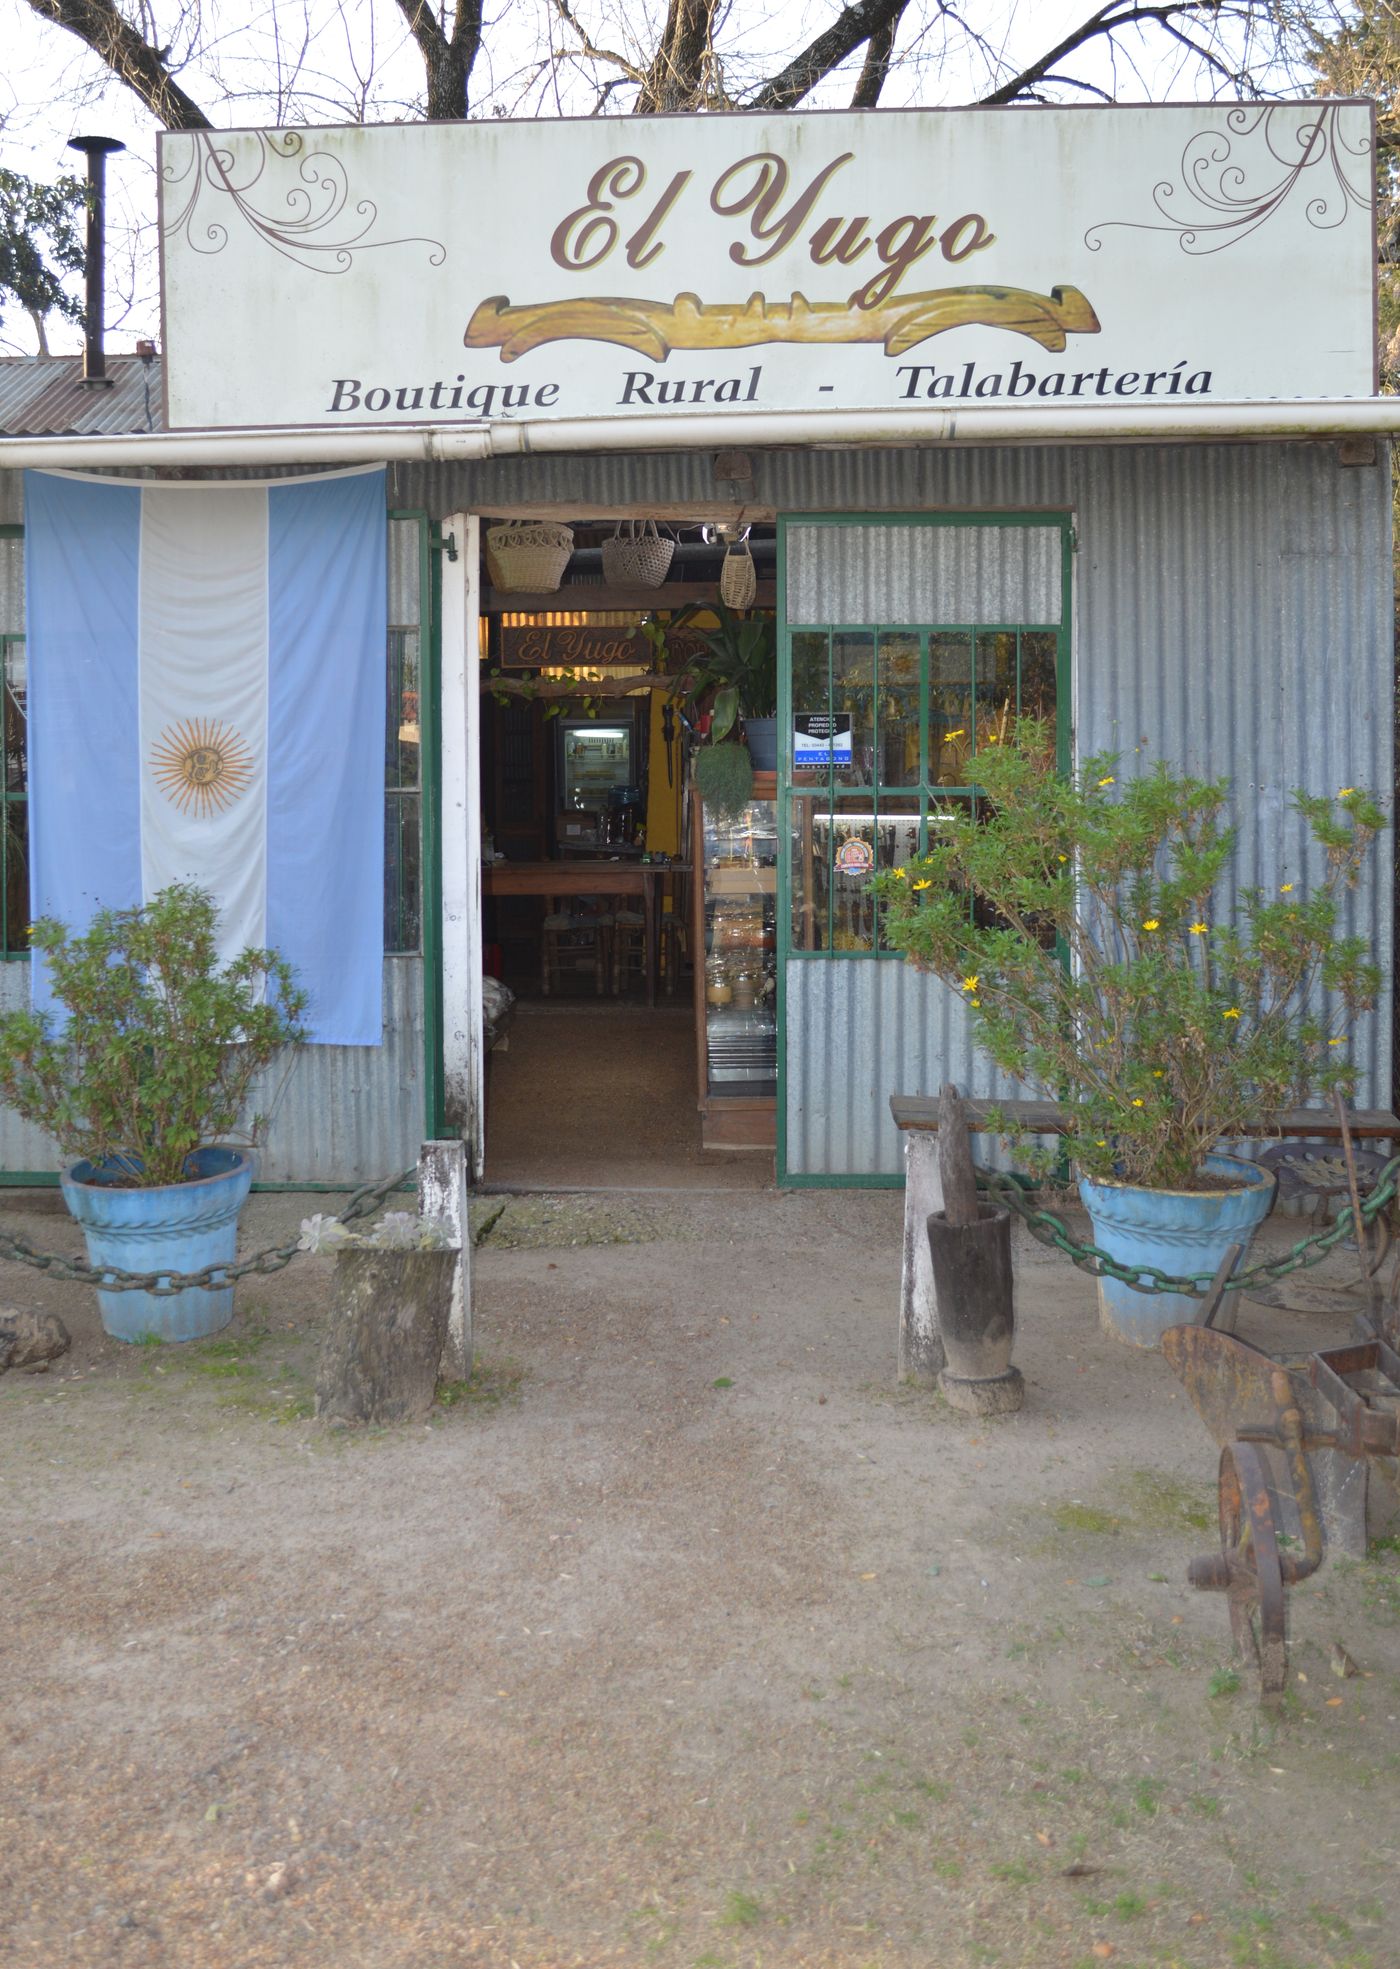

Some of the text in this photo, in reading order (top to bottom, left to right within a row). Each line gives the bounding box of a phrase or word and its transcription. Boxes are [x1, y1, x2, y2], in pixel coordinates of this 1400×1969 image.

[550, 152, 996, 311] El Yugo
[326, 375, 559, 417] Boutique
[616, 366, 763, 405] Rural
[895, 358, 1213, 400] Talabartería
[519, 631, 552, 660] El
[557, 630, 636, 664] Yugo
